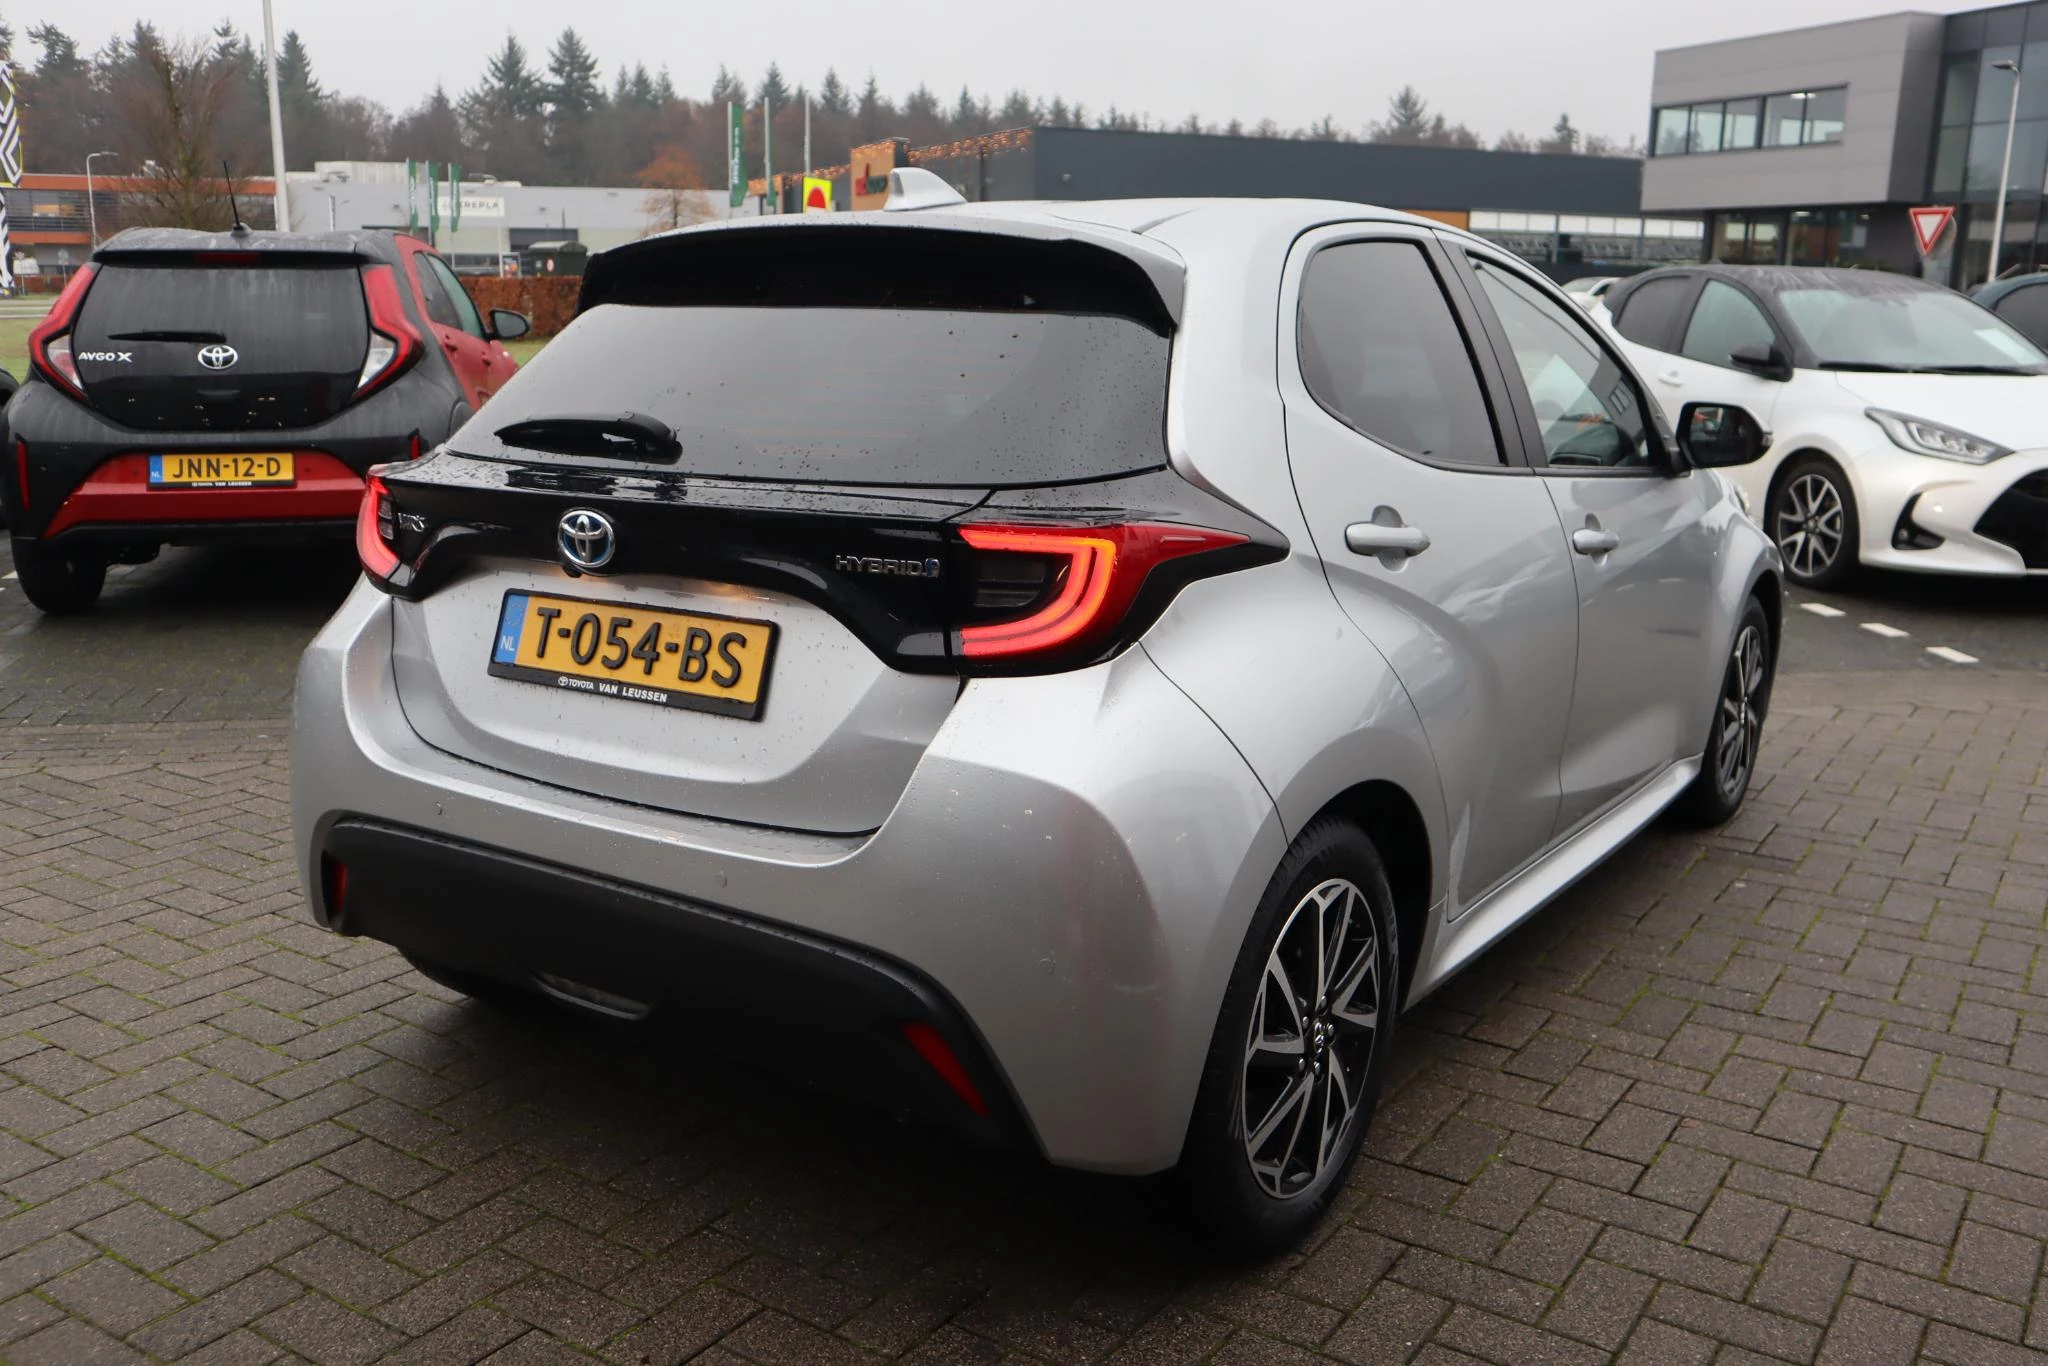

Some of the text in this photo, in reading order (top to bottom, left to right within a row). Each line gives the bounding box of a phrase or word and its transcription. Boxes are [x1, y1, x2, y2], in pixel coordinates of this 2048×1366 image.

[78, 352, 133, 363] AYGO X
[151, 471, 161, 479] NL
[172, 457, 281, 479] JNN-12-D
[835, 554, 923, 576] HYBRID
[500, 635, 516, 652] NL
[536, 606, 748, 688] T-054-BS
[568, 678, 668, 703] TOYOTA VAN LEUSSEN
